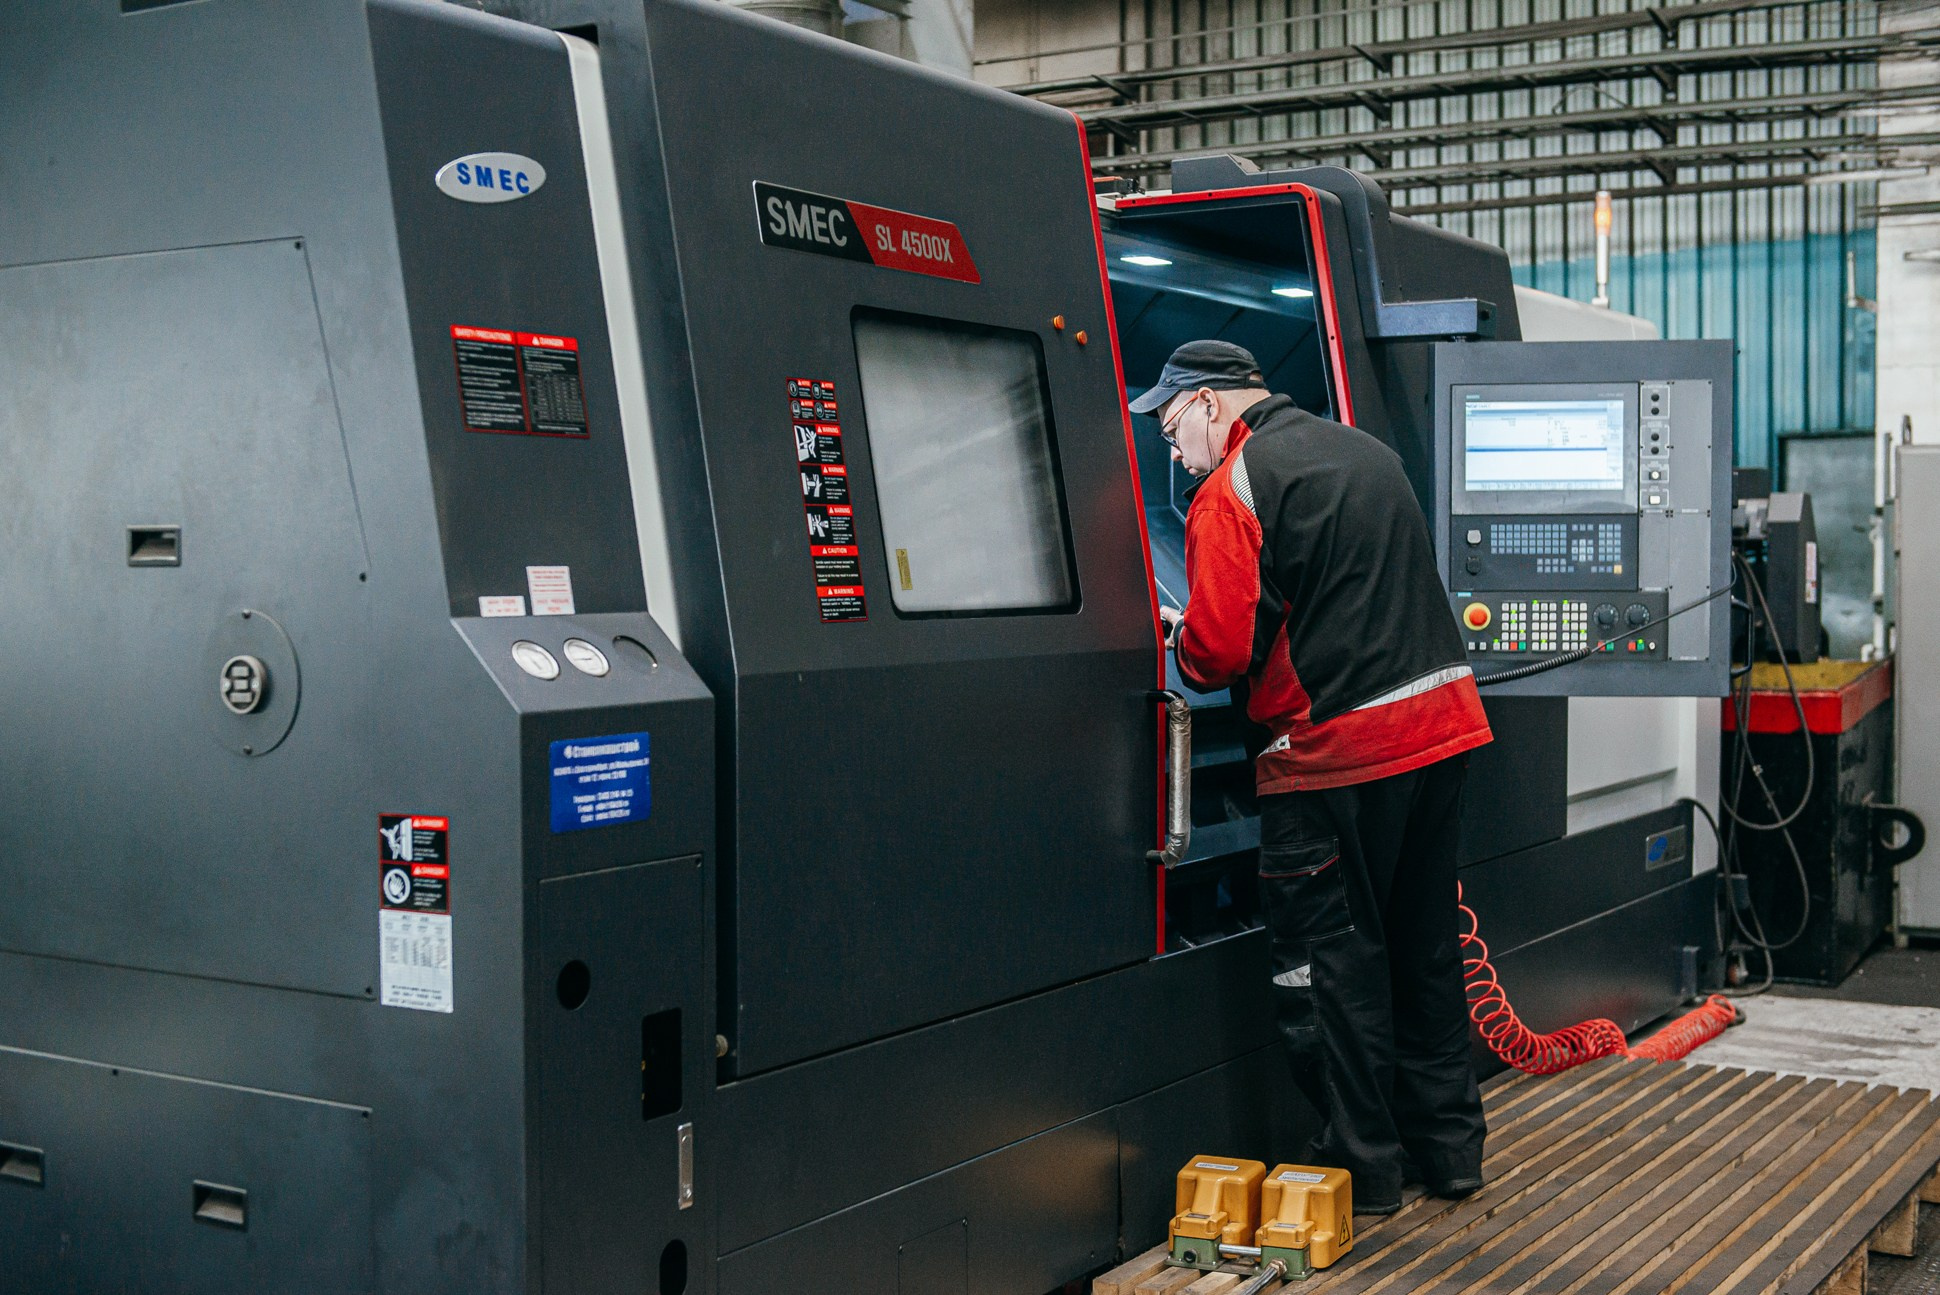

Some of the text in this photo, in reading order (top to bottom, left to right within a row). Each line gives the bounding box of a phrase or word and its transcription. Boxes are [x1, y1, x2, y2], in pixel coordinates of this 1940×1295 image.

[456, 162, 530, 194] SMEC
[767, 197, 954, 263] SMEC SL 4500X
